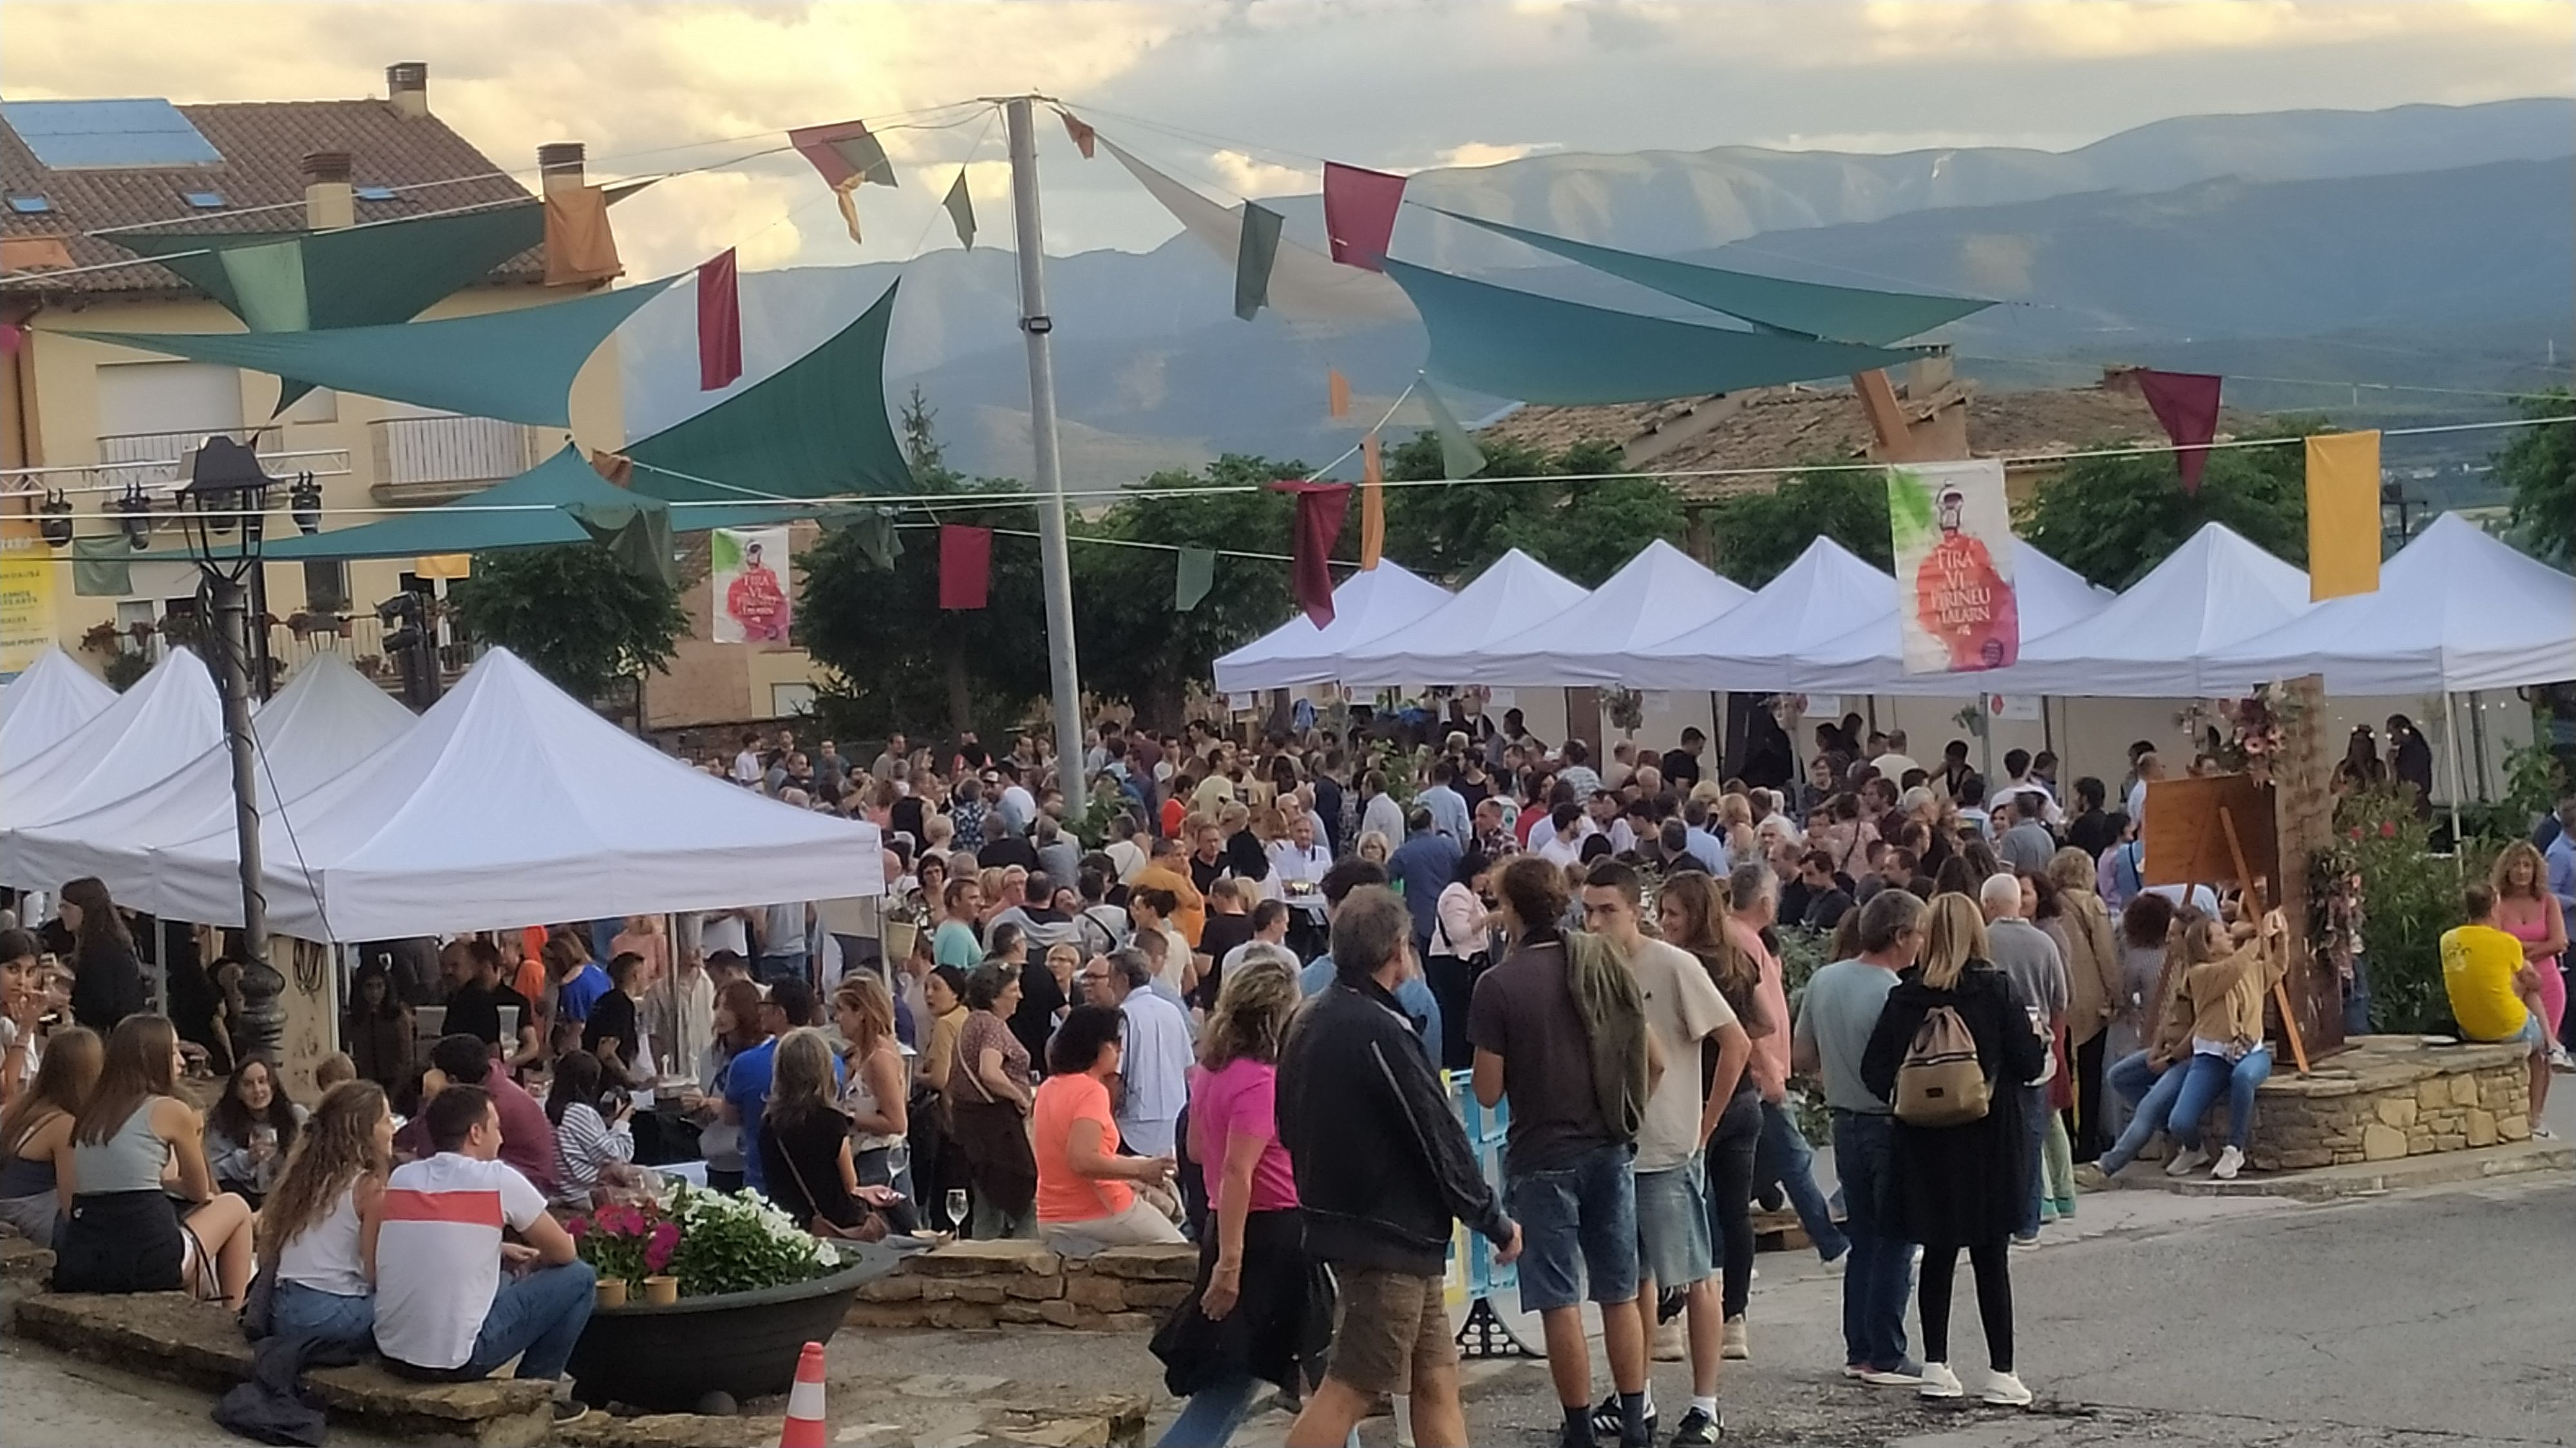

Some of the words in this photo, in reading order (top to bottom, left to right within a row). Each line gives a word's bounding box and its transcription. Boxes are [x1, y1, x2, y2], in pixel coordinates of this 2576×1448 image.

[1938, 549, 1974, 569] FIRA
[1945, 569, 1964, 589] VI
[1931, 587, 1990, 608] PIRINEU
[1942, 606, 1990, 624] TALARN
